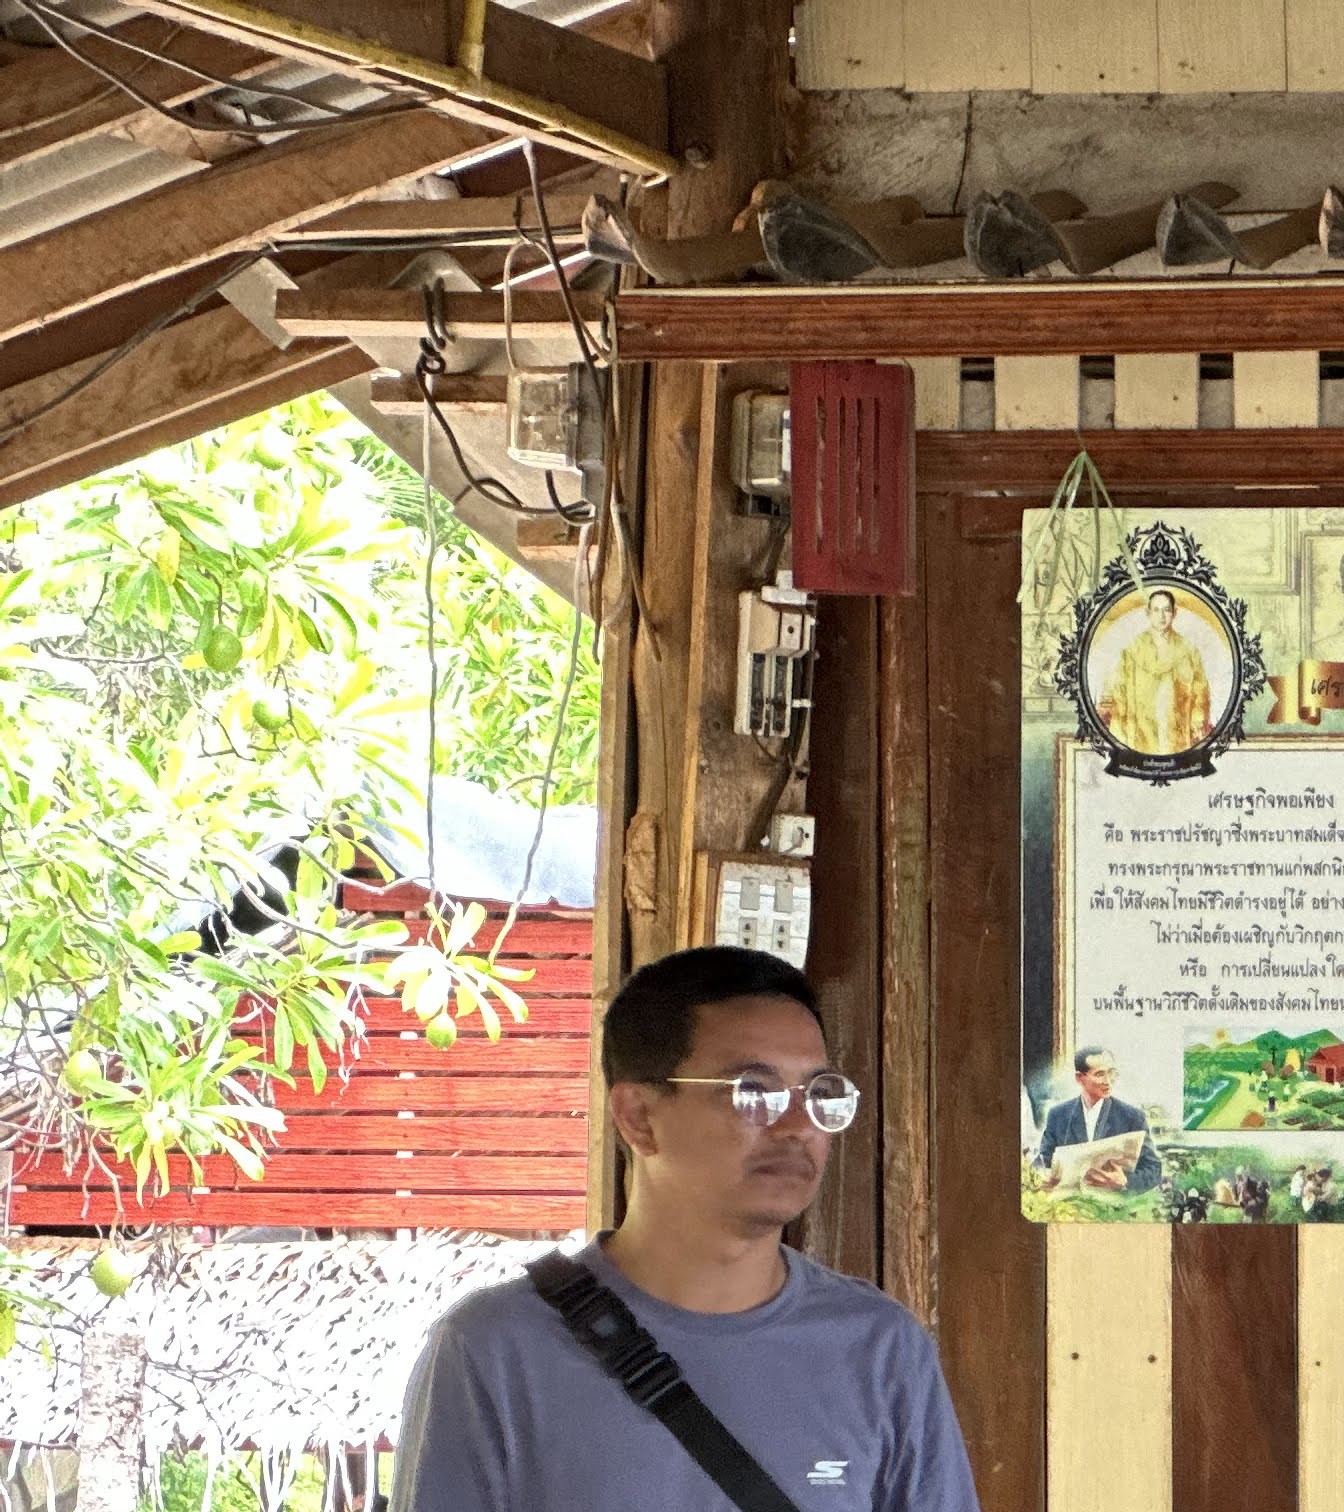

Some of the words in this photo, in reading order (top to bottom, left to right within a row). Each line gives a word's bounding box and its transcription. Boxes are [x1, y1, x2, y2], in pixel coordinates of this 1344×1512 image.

[1208, 786, 1335, 817] เศรษฐกิจพอเพียง
